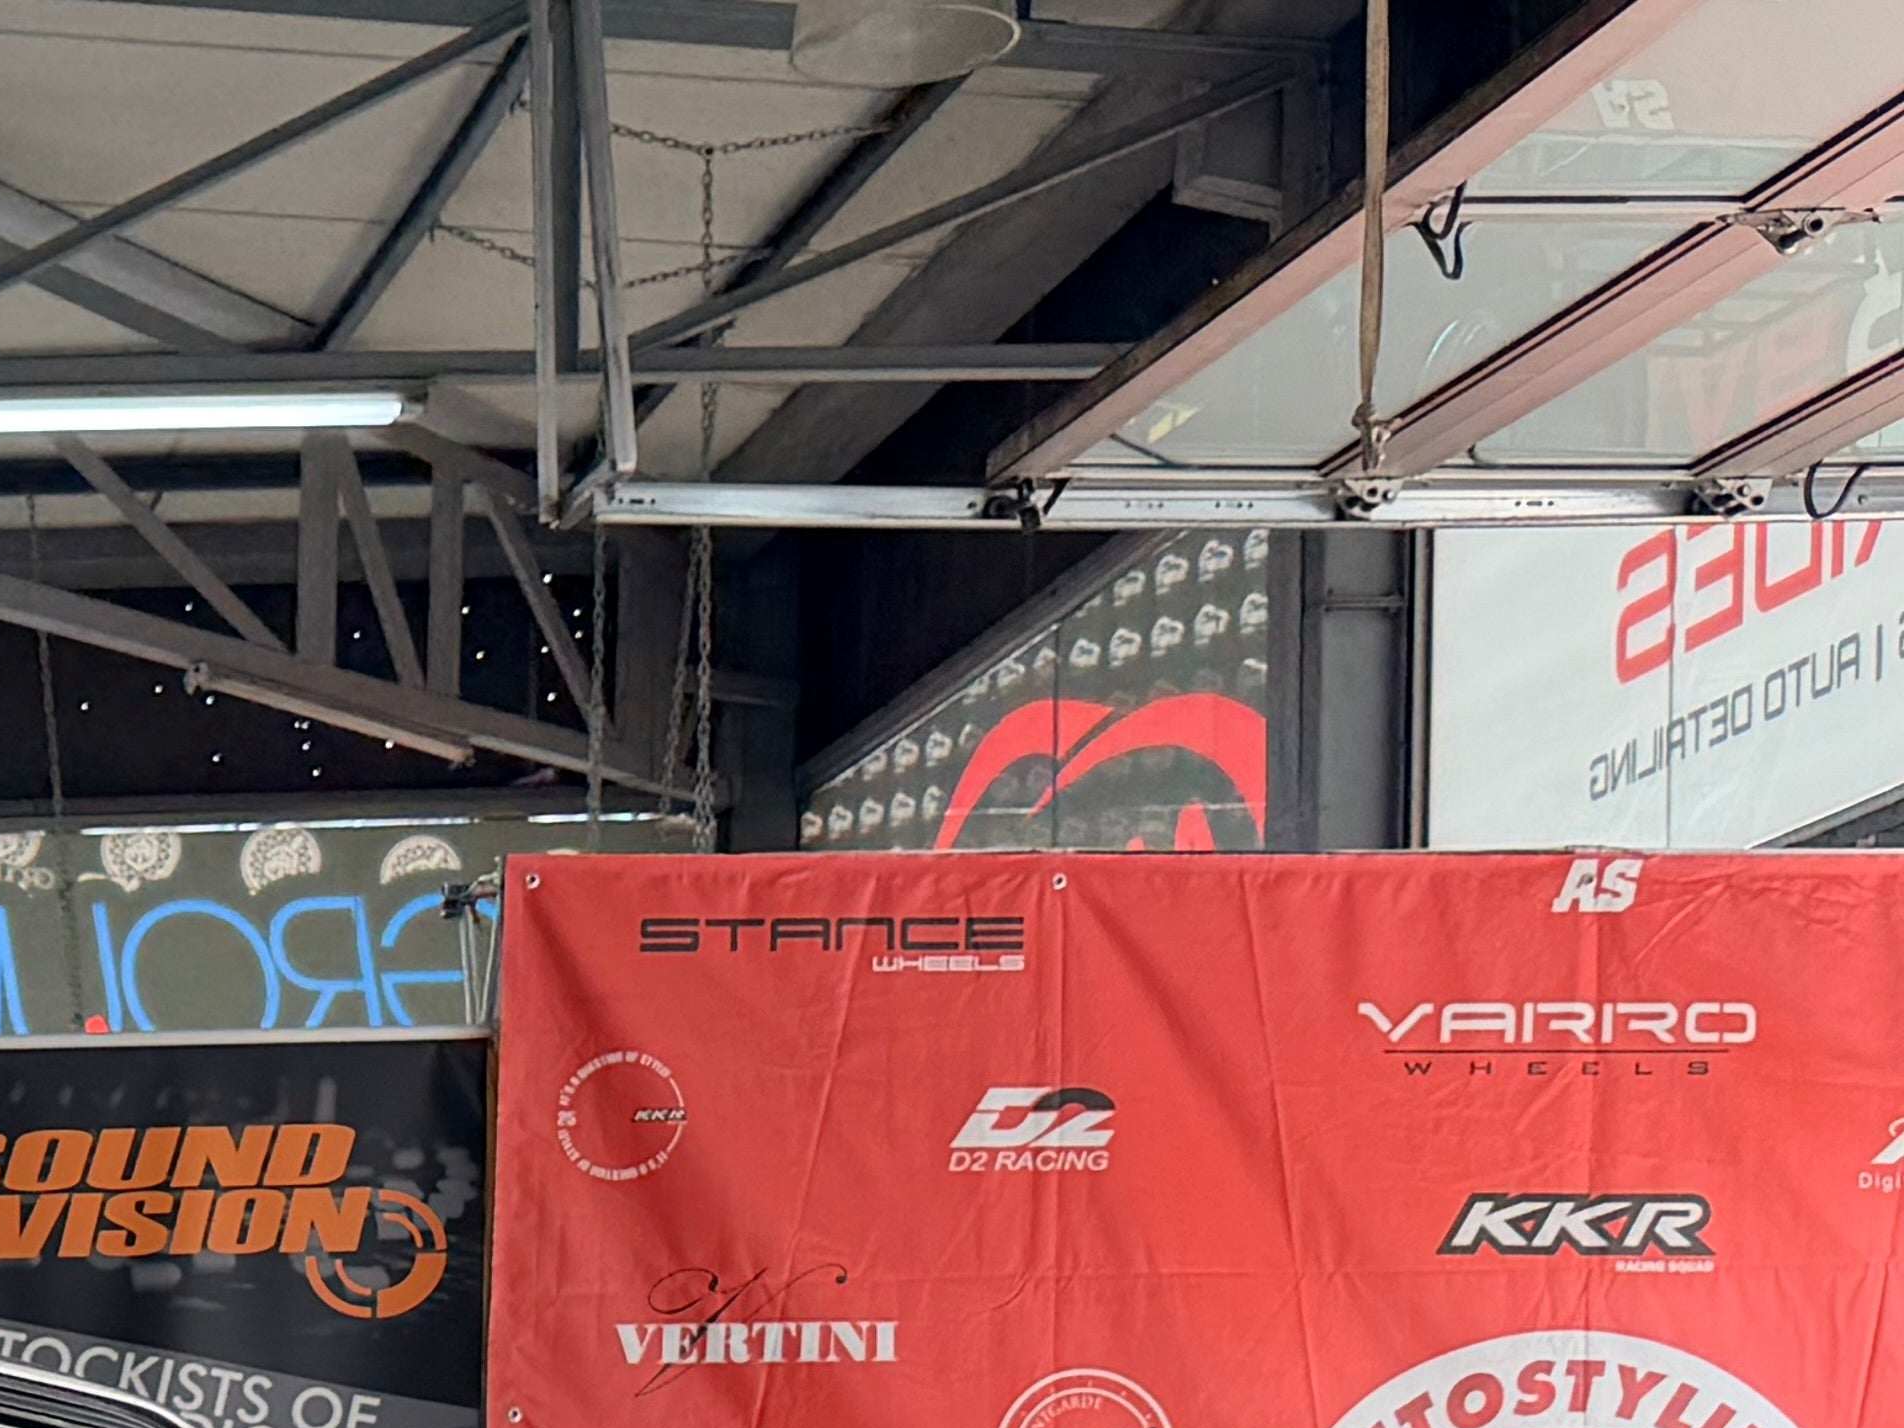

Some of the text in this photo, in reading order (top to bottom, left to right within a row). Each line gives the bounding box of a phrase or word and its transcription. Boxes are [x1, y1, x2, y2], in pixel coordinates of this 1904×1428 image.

[1551, 859, 1643, 913] AS
[639, 916, 1024, 953] STANCE
[872, 955, 1025, 972] WHEELS
[1358, 1001, 1757, 1044] VARRO
[1405, 1061, 1709, 1076] WHEELS
[948, 1150, 1110, 1172] D2 RACING
[1858, 1170, 1904, 1194] Digi
[1444, 1196, 1710, 1252] KKR
[614, 1321, 899, 1364] VERTINI
